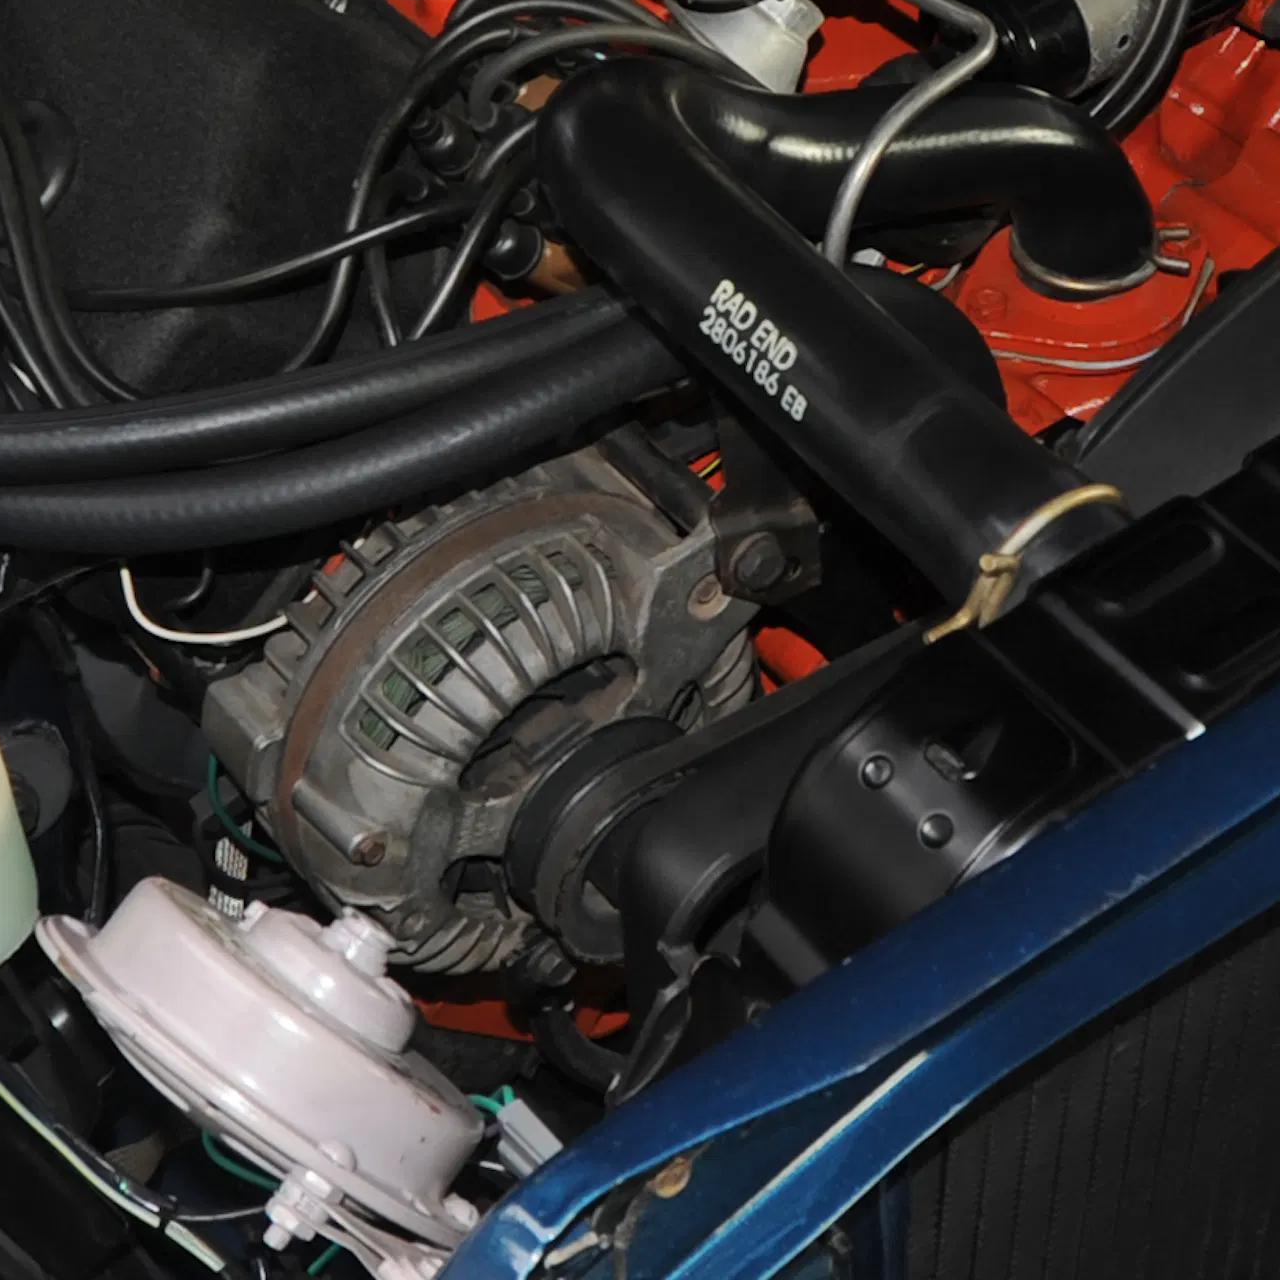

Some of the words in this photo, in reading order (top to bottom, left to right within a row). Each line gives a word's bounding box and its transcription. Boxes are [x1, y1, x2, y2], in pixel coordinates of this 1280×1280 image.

[699, 305, 780, 396] 2806186
[780, 384, 808, 421] EB
[710, 279, 758, 331] RAD
[750, 319, 798, 371] END
